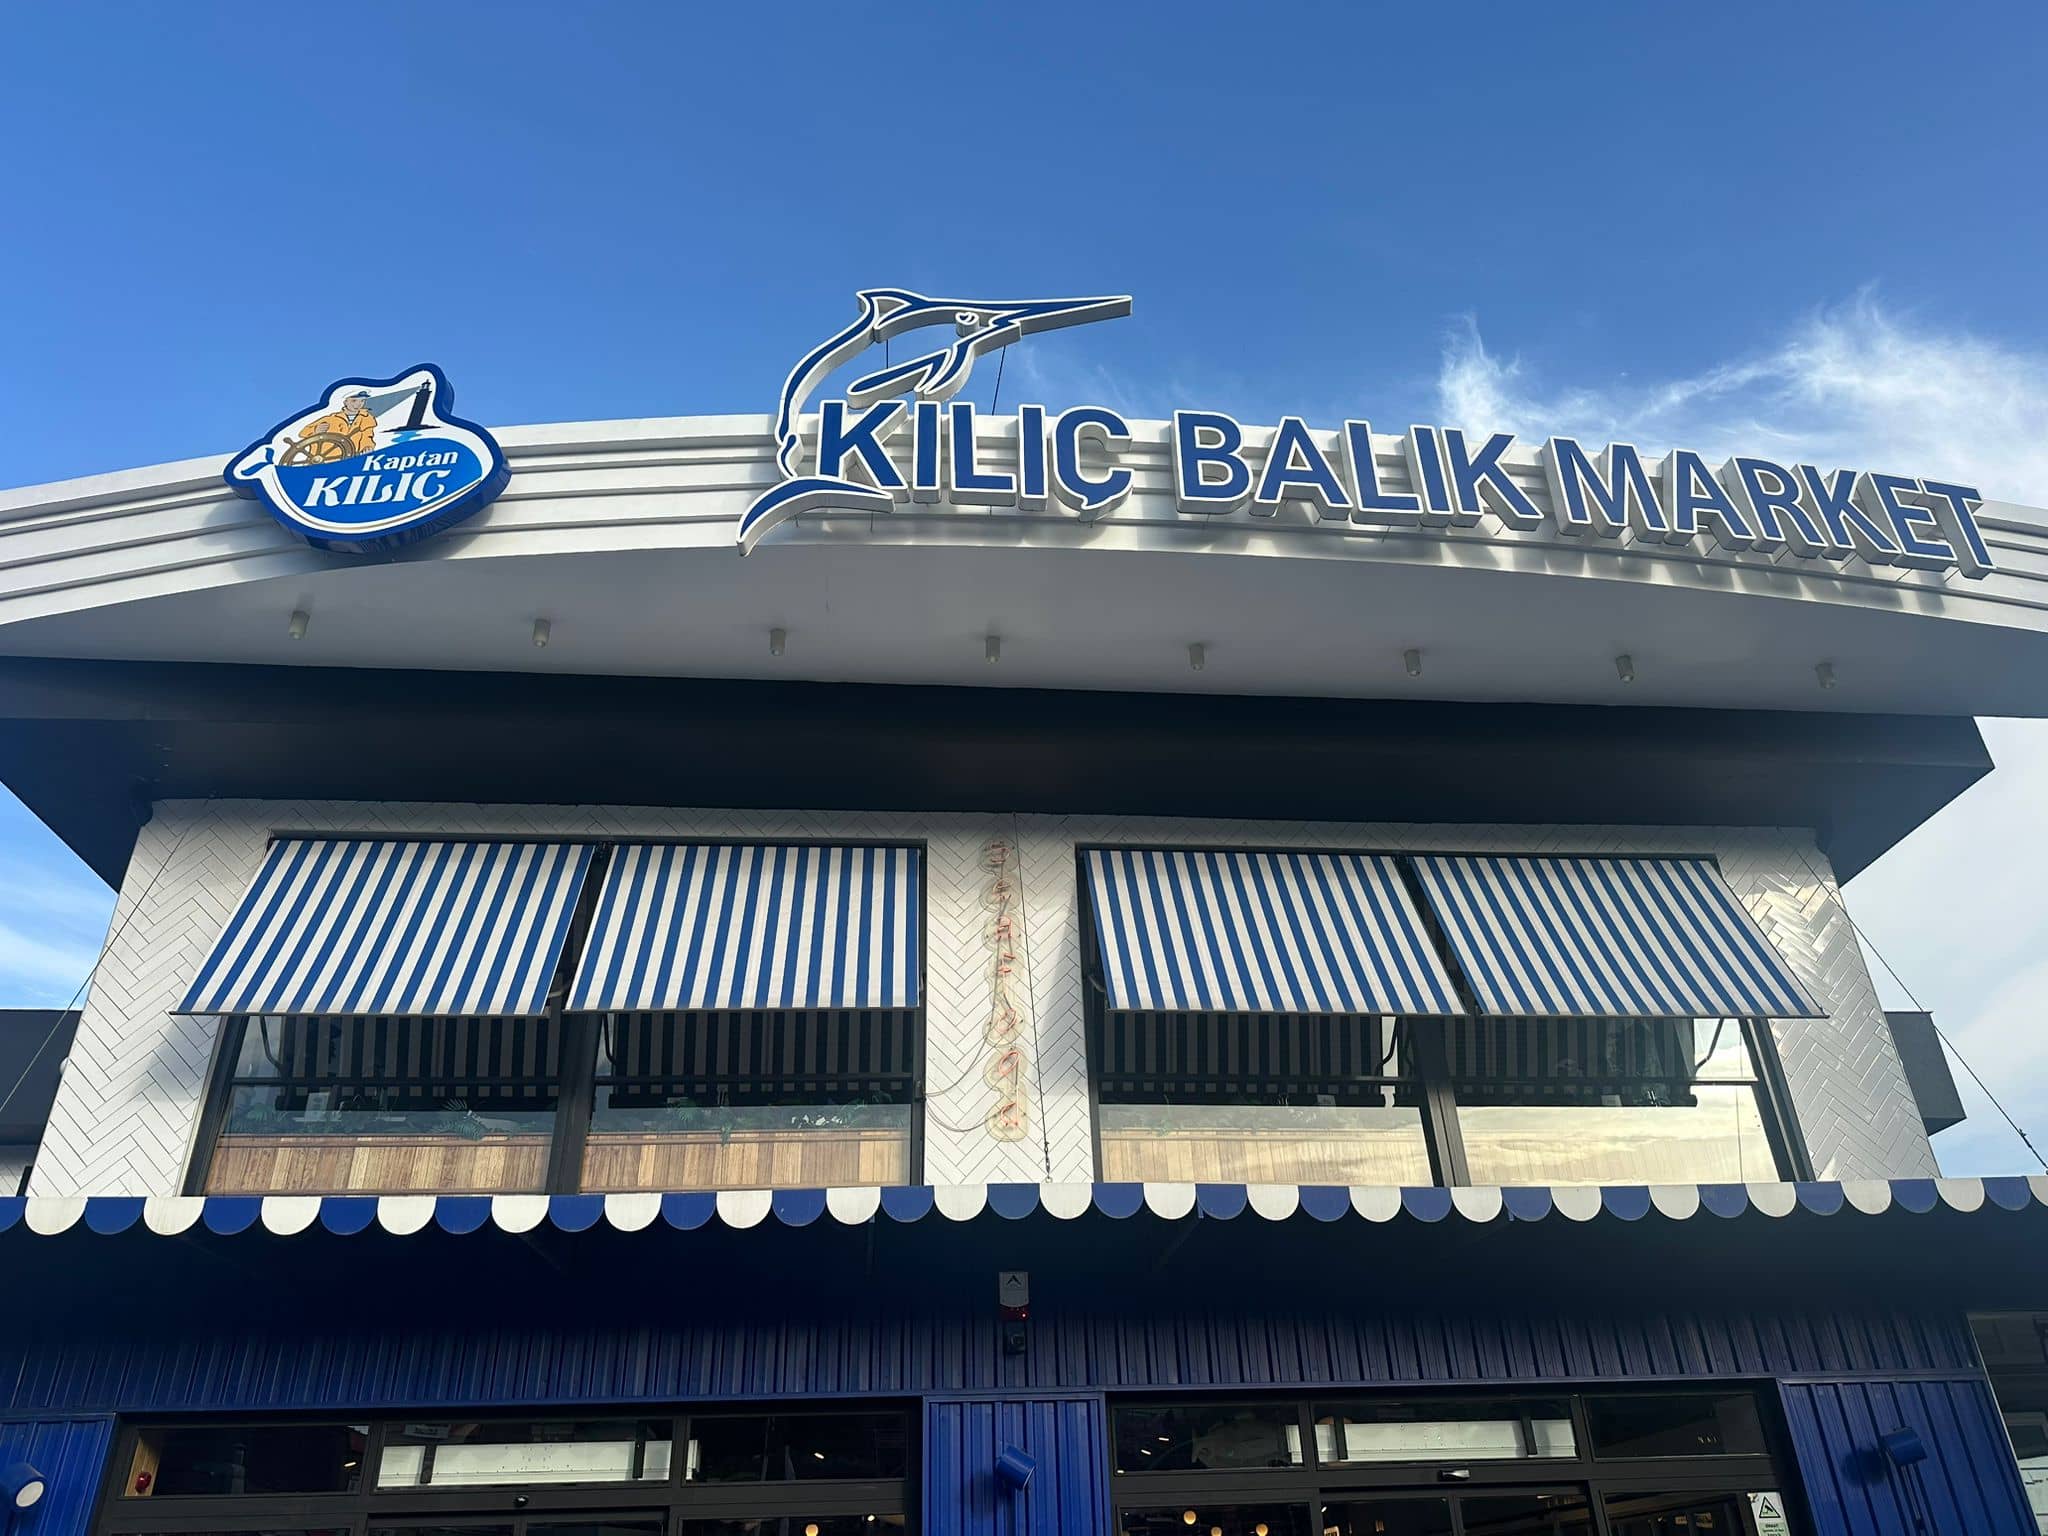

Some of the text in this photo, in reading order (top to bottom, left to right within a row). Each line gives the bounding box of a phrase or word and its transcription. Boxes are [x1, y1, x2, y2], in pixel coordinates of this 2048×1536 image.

[362, 450, 459, 473] Kaptan
[302, 469, 451, 508] KILIÇ
[815, 400, 1997, 571] KILIÇ BALIK MARKET
